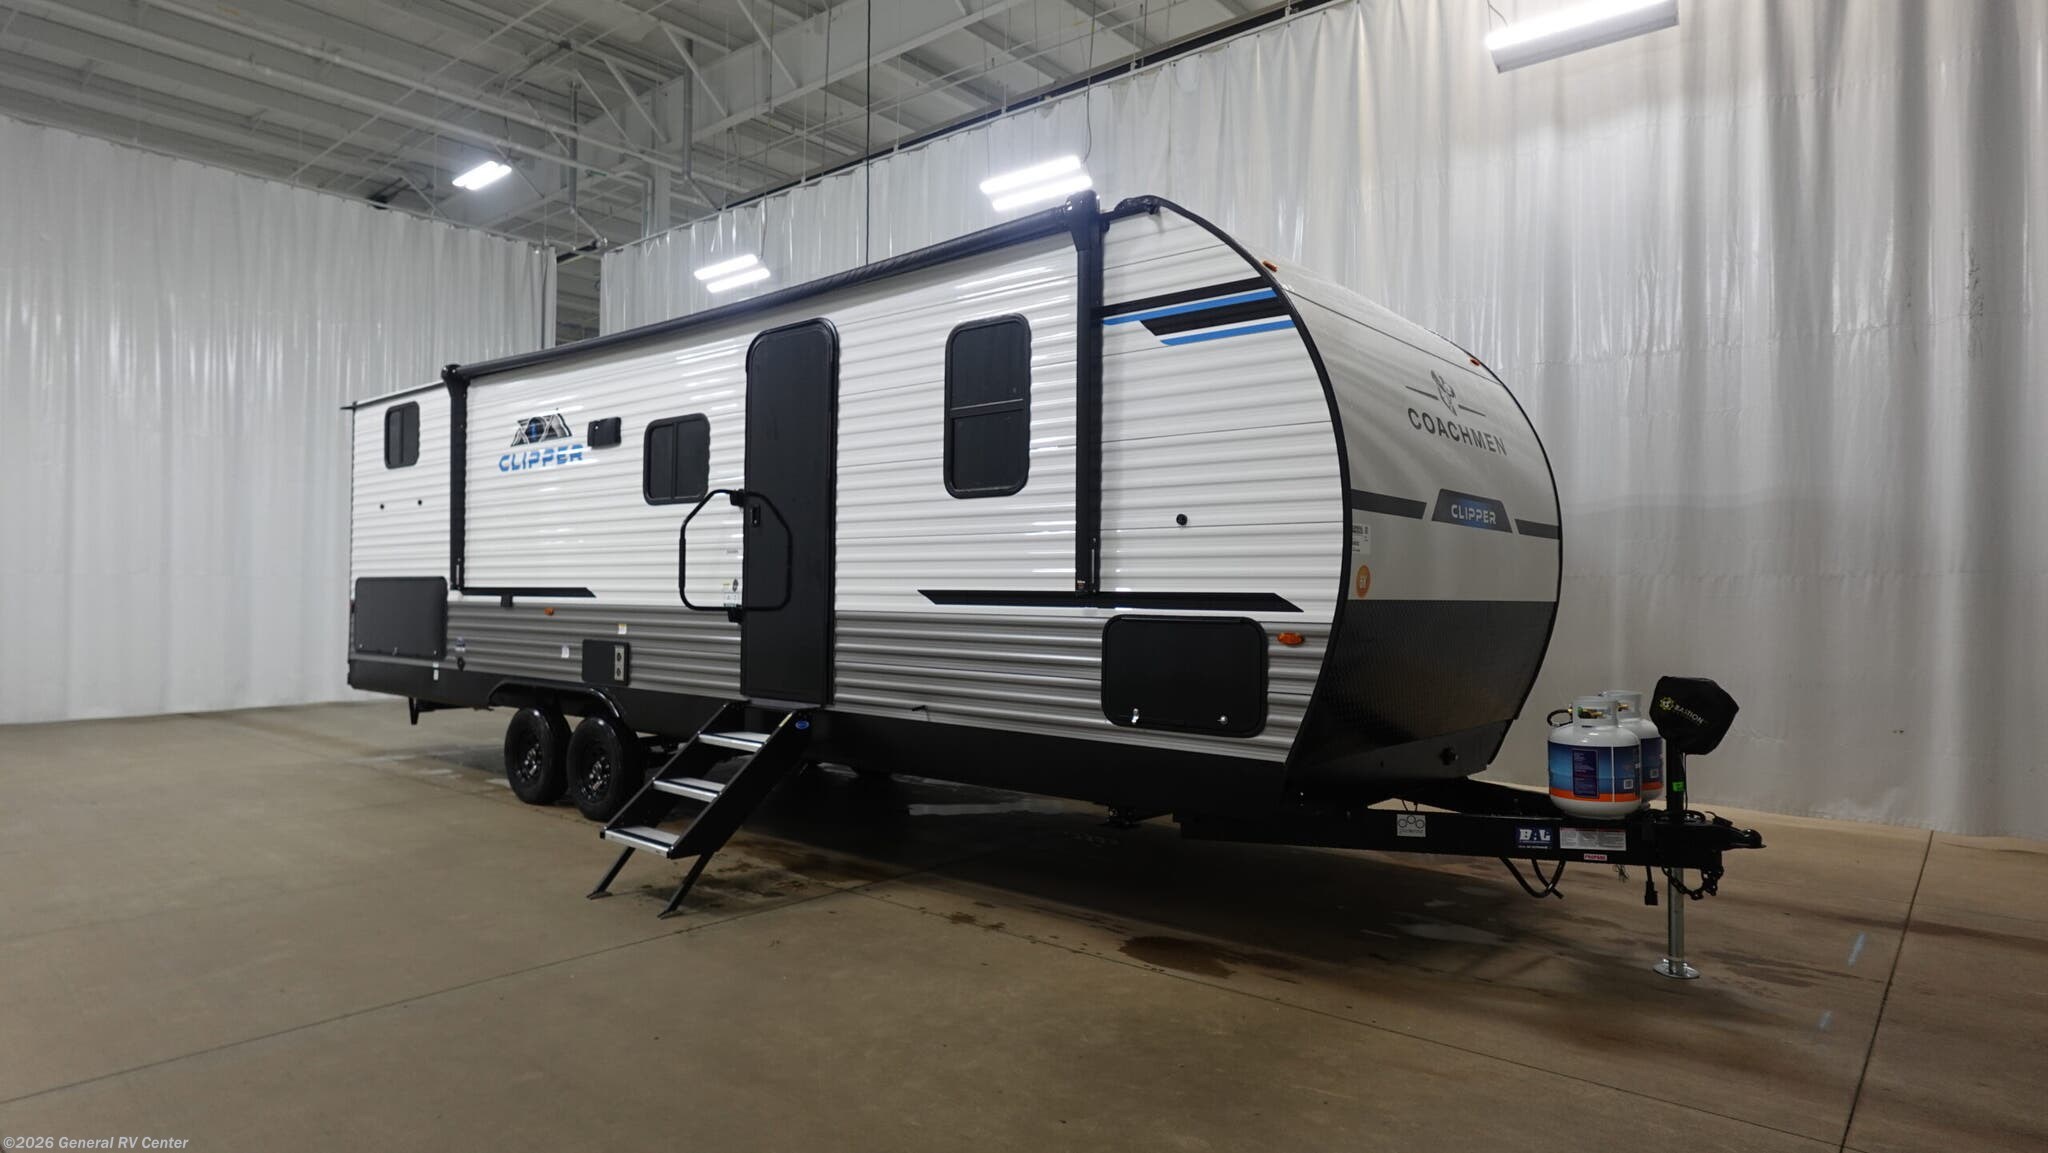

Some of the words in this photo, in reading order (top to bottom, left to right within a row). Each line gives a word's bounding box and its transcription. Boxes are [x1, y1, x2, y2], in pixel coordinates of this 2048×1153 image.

[1407, 407, 1508, 456] COACHMEN
[498, 444, 584, 473] CLIPPER
[1450, 504, 1497, 525] CLIPPER
